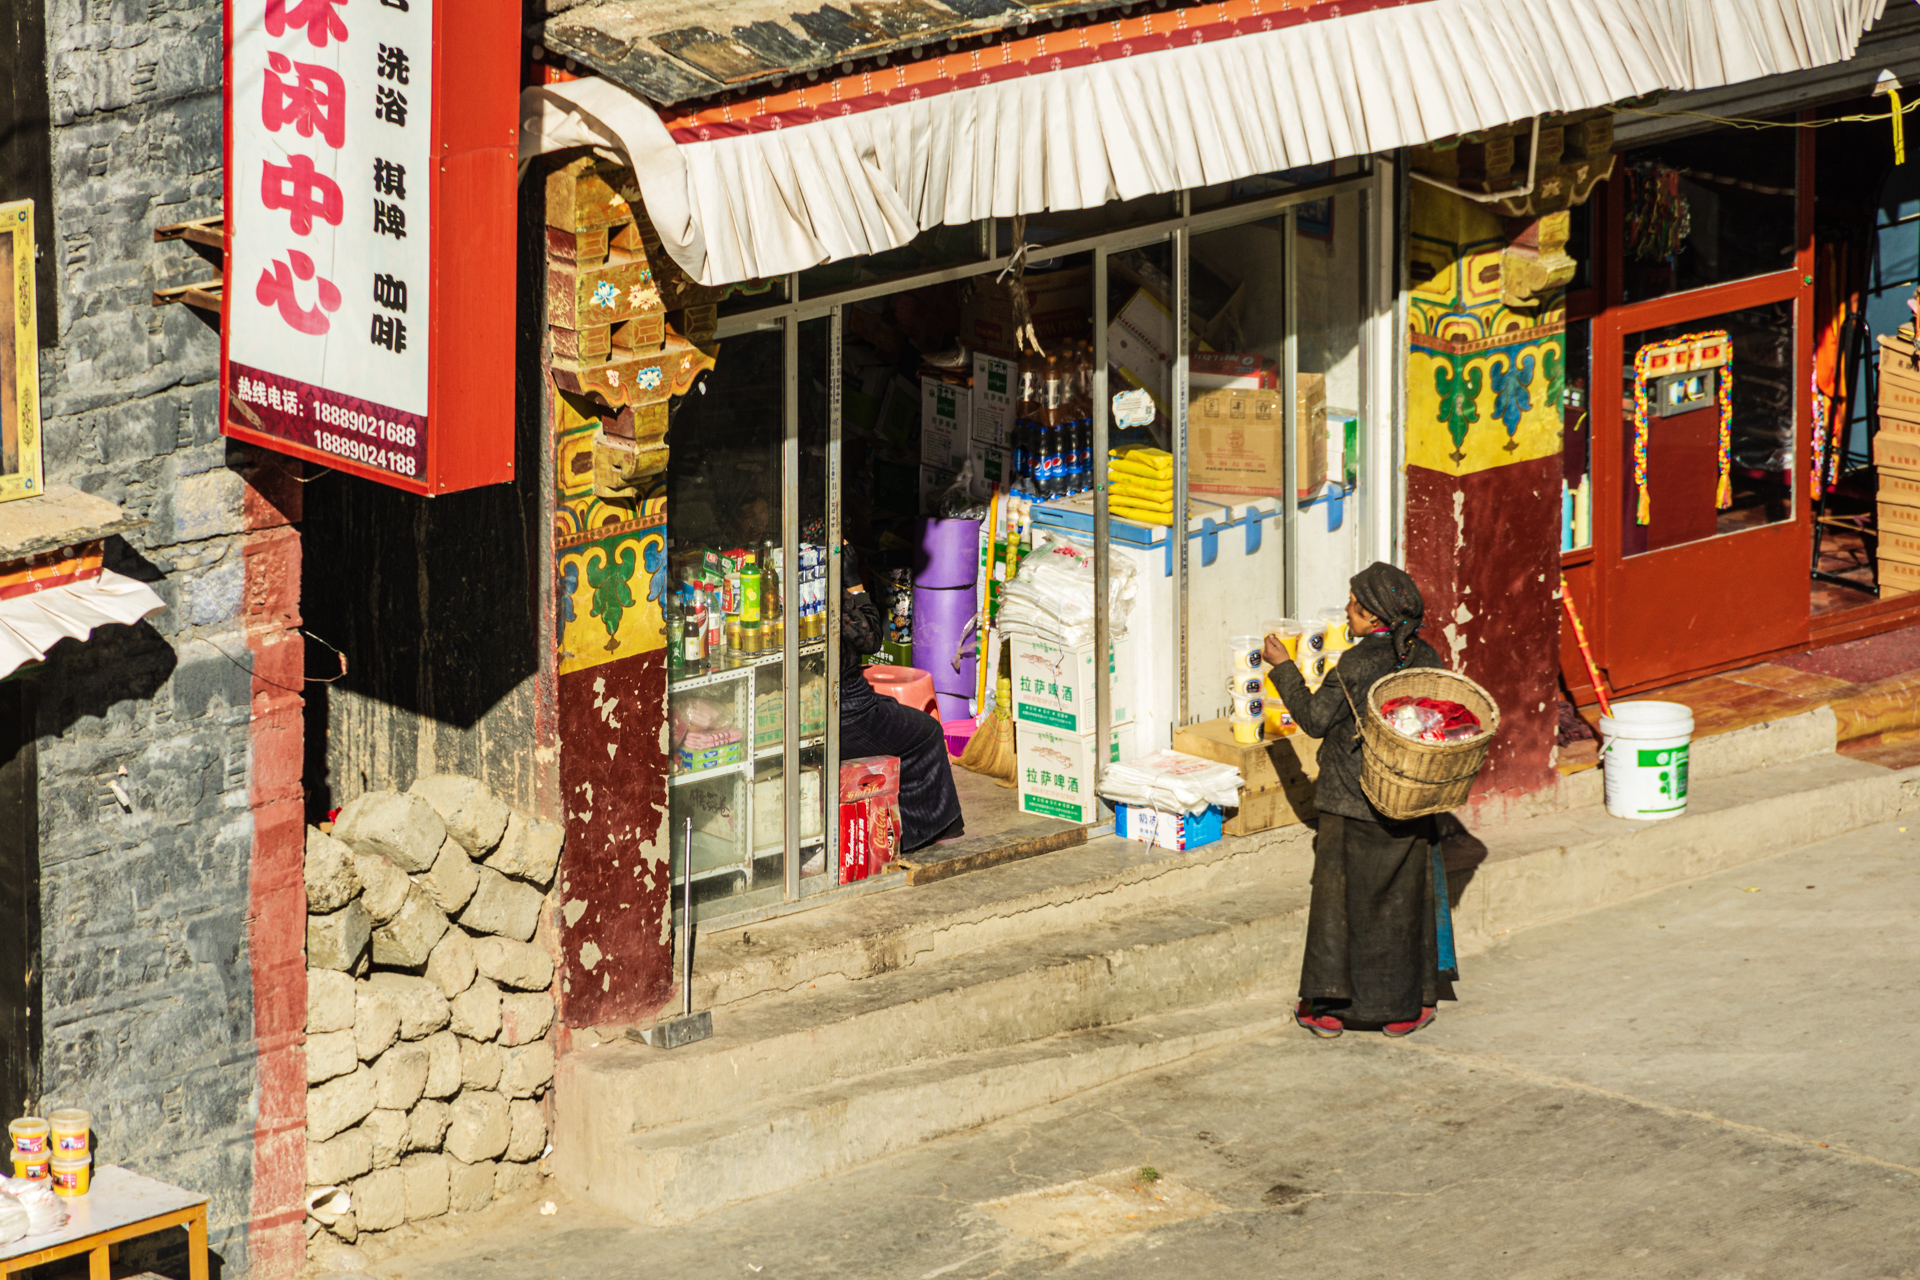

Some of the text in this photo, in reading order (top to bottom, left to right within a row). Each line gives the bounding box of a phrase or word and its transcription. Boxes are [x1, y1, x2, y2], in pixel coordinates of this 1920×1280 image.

[375, 42, 410, 127] 洗浴
[373, 157, 407, 240] 棋牌
[370, 272, 407, 354] 咖啡
[312, 400, 416, 448] 18889021688
[313, 430, 416, 476] 18889024188
[1020, 675, 1073, 703] 拉萨啤酒
[1026, 767, 1079, 794] 拉萨啤酒
[845, 819, 856, 868] Budweiser
